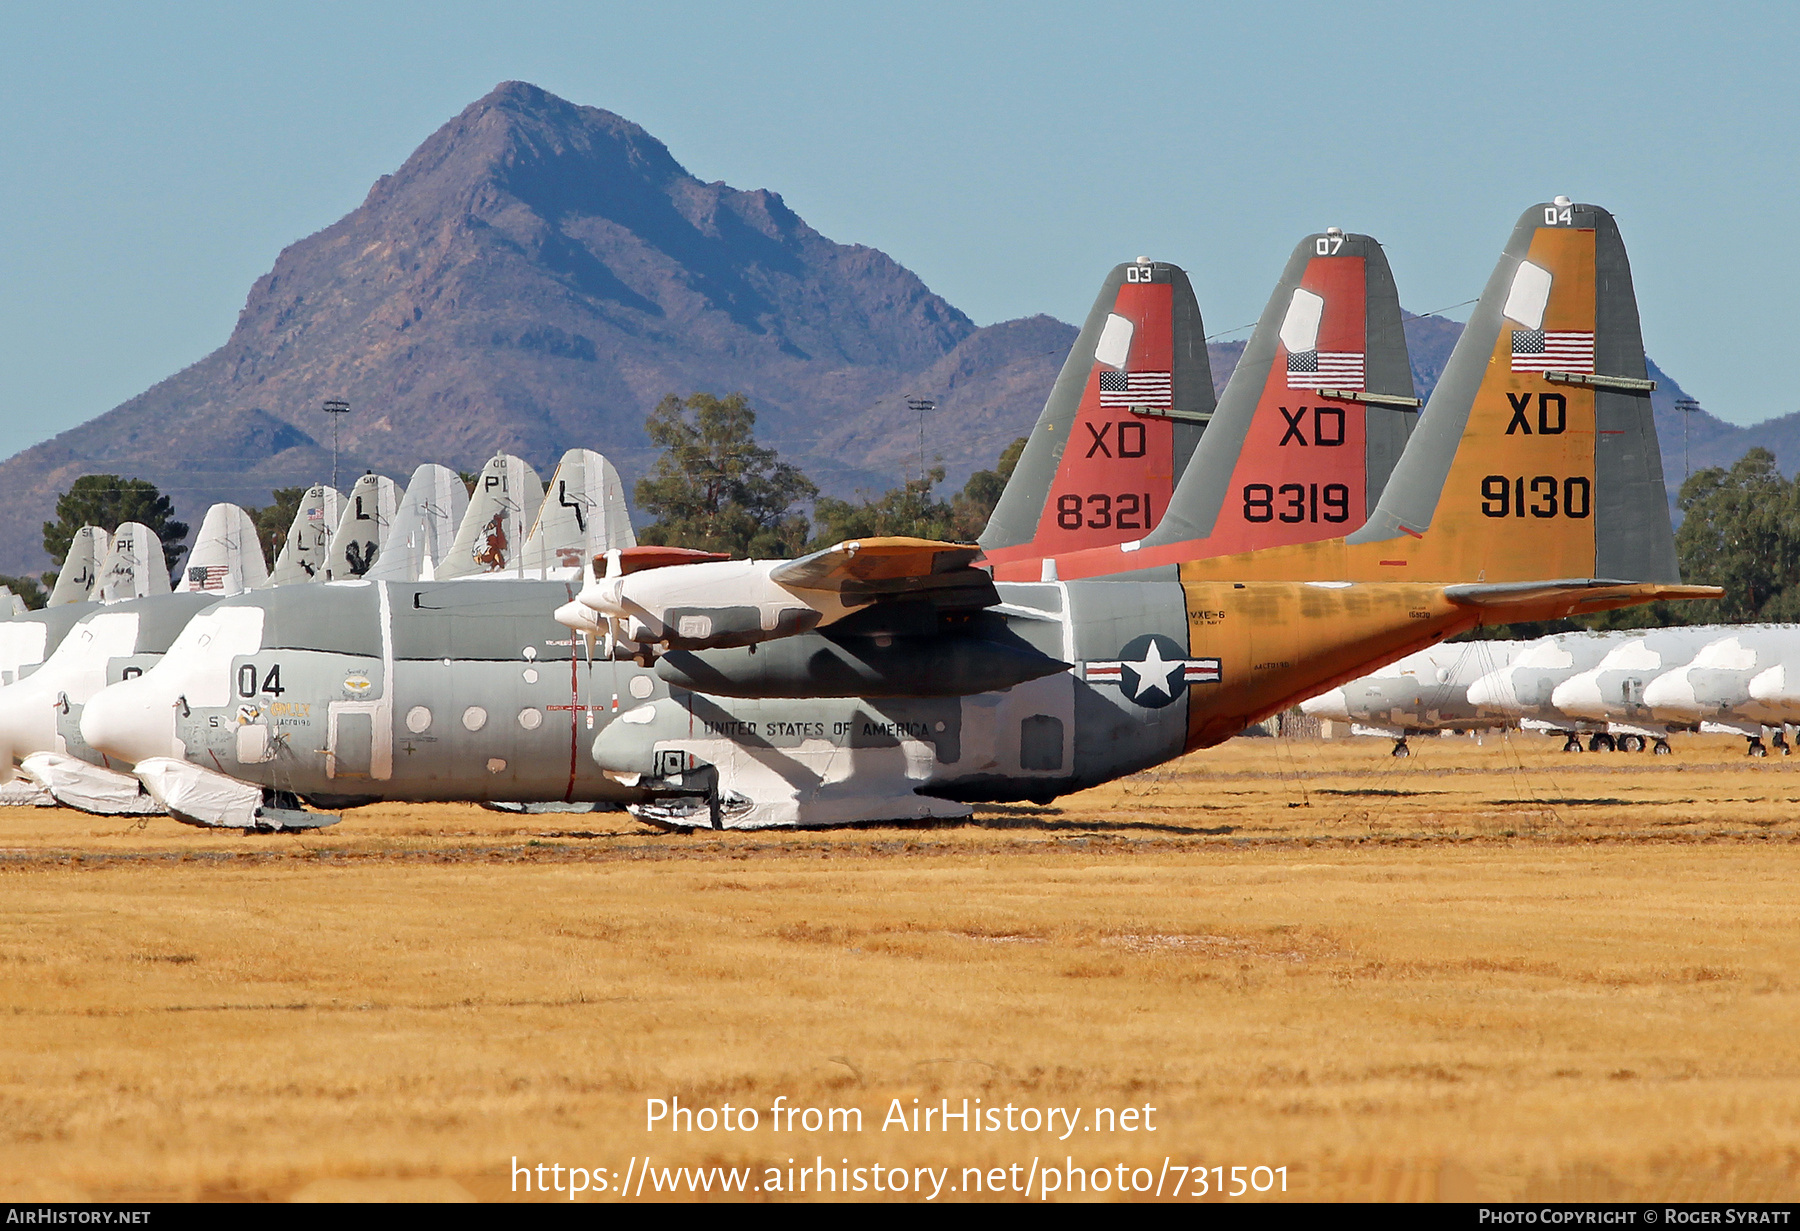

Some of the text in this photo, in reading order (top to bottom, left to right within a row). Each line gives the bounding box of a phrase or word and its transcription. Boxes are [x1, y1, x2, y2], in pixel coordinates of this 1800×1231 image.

[1544, 207, 1573, 226] 04
[1316, 238, 1344, 256] 07
[1126, 266, 1152, 283] 03
[1278, 406, 1345, 447] XD
[1504, 392, 1567, 435] XD
[1085, 422, 1146, 459] XD
[1057, 493, 1151, 531] 8321
[1243, 483, 1349, 523] 8319
[1481, 475, 1590, 519] 9130
[1190, 611, 1225, 620] VXE-6
[238, 663, 286, 699] 04
[209, 716, 219, 728] S
[703, 720, 930, 738] UNITED STATES OF AMERICA
